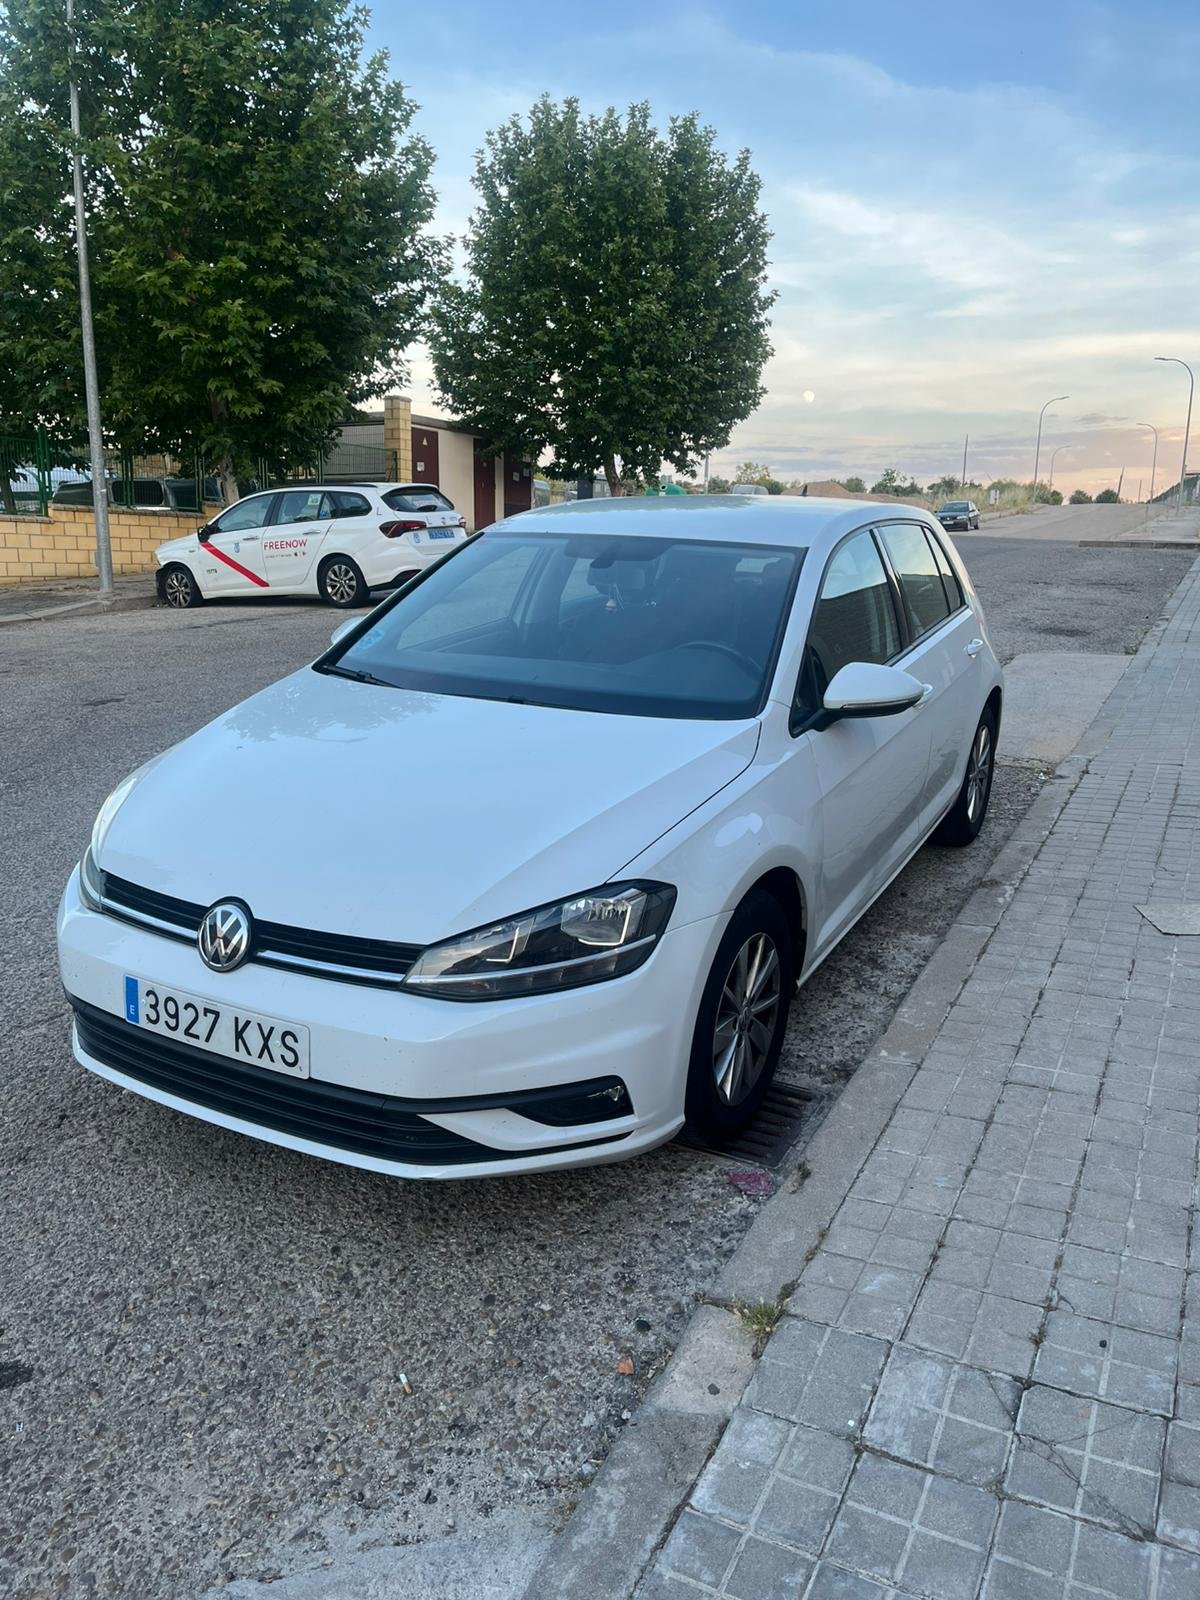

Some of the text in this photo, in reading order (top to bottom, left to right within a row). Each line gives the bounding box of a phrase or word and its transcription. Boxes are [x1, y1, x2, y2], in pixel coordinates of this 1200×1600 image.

[263, 539, 308, 551] FREENOW
[129, 989, 299, 1068] E 3927 KXS
